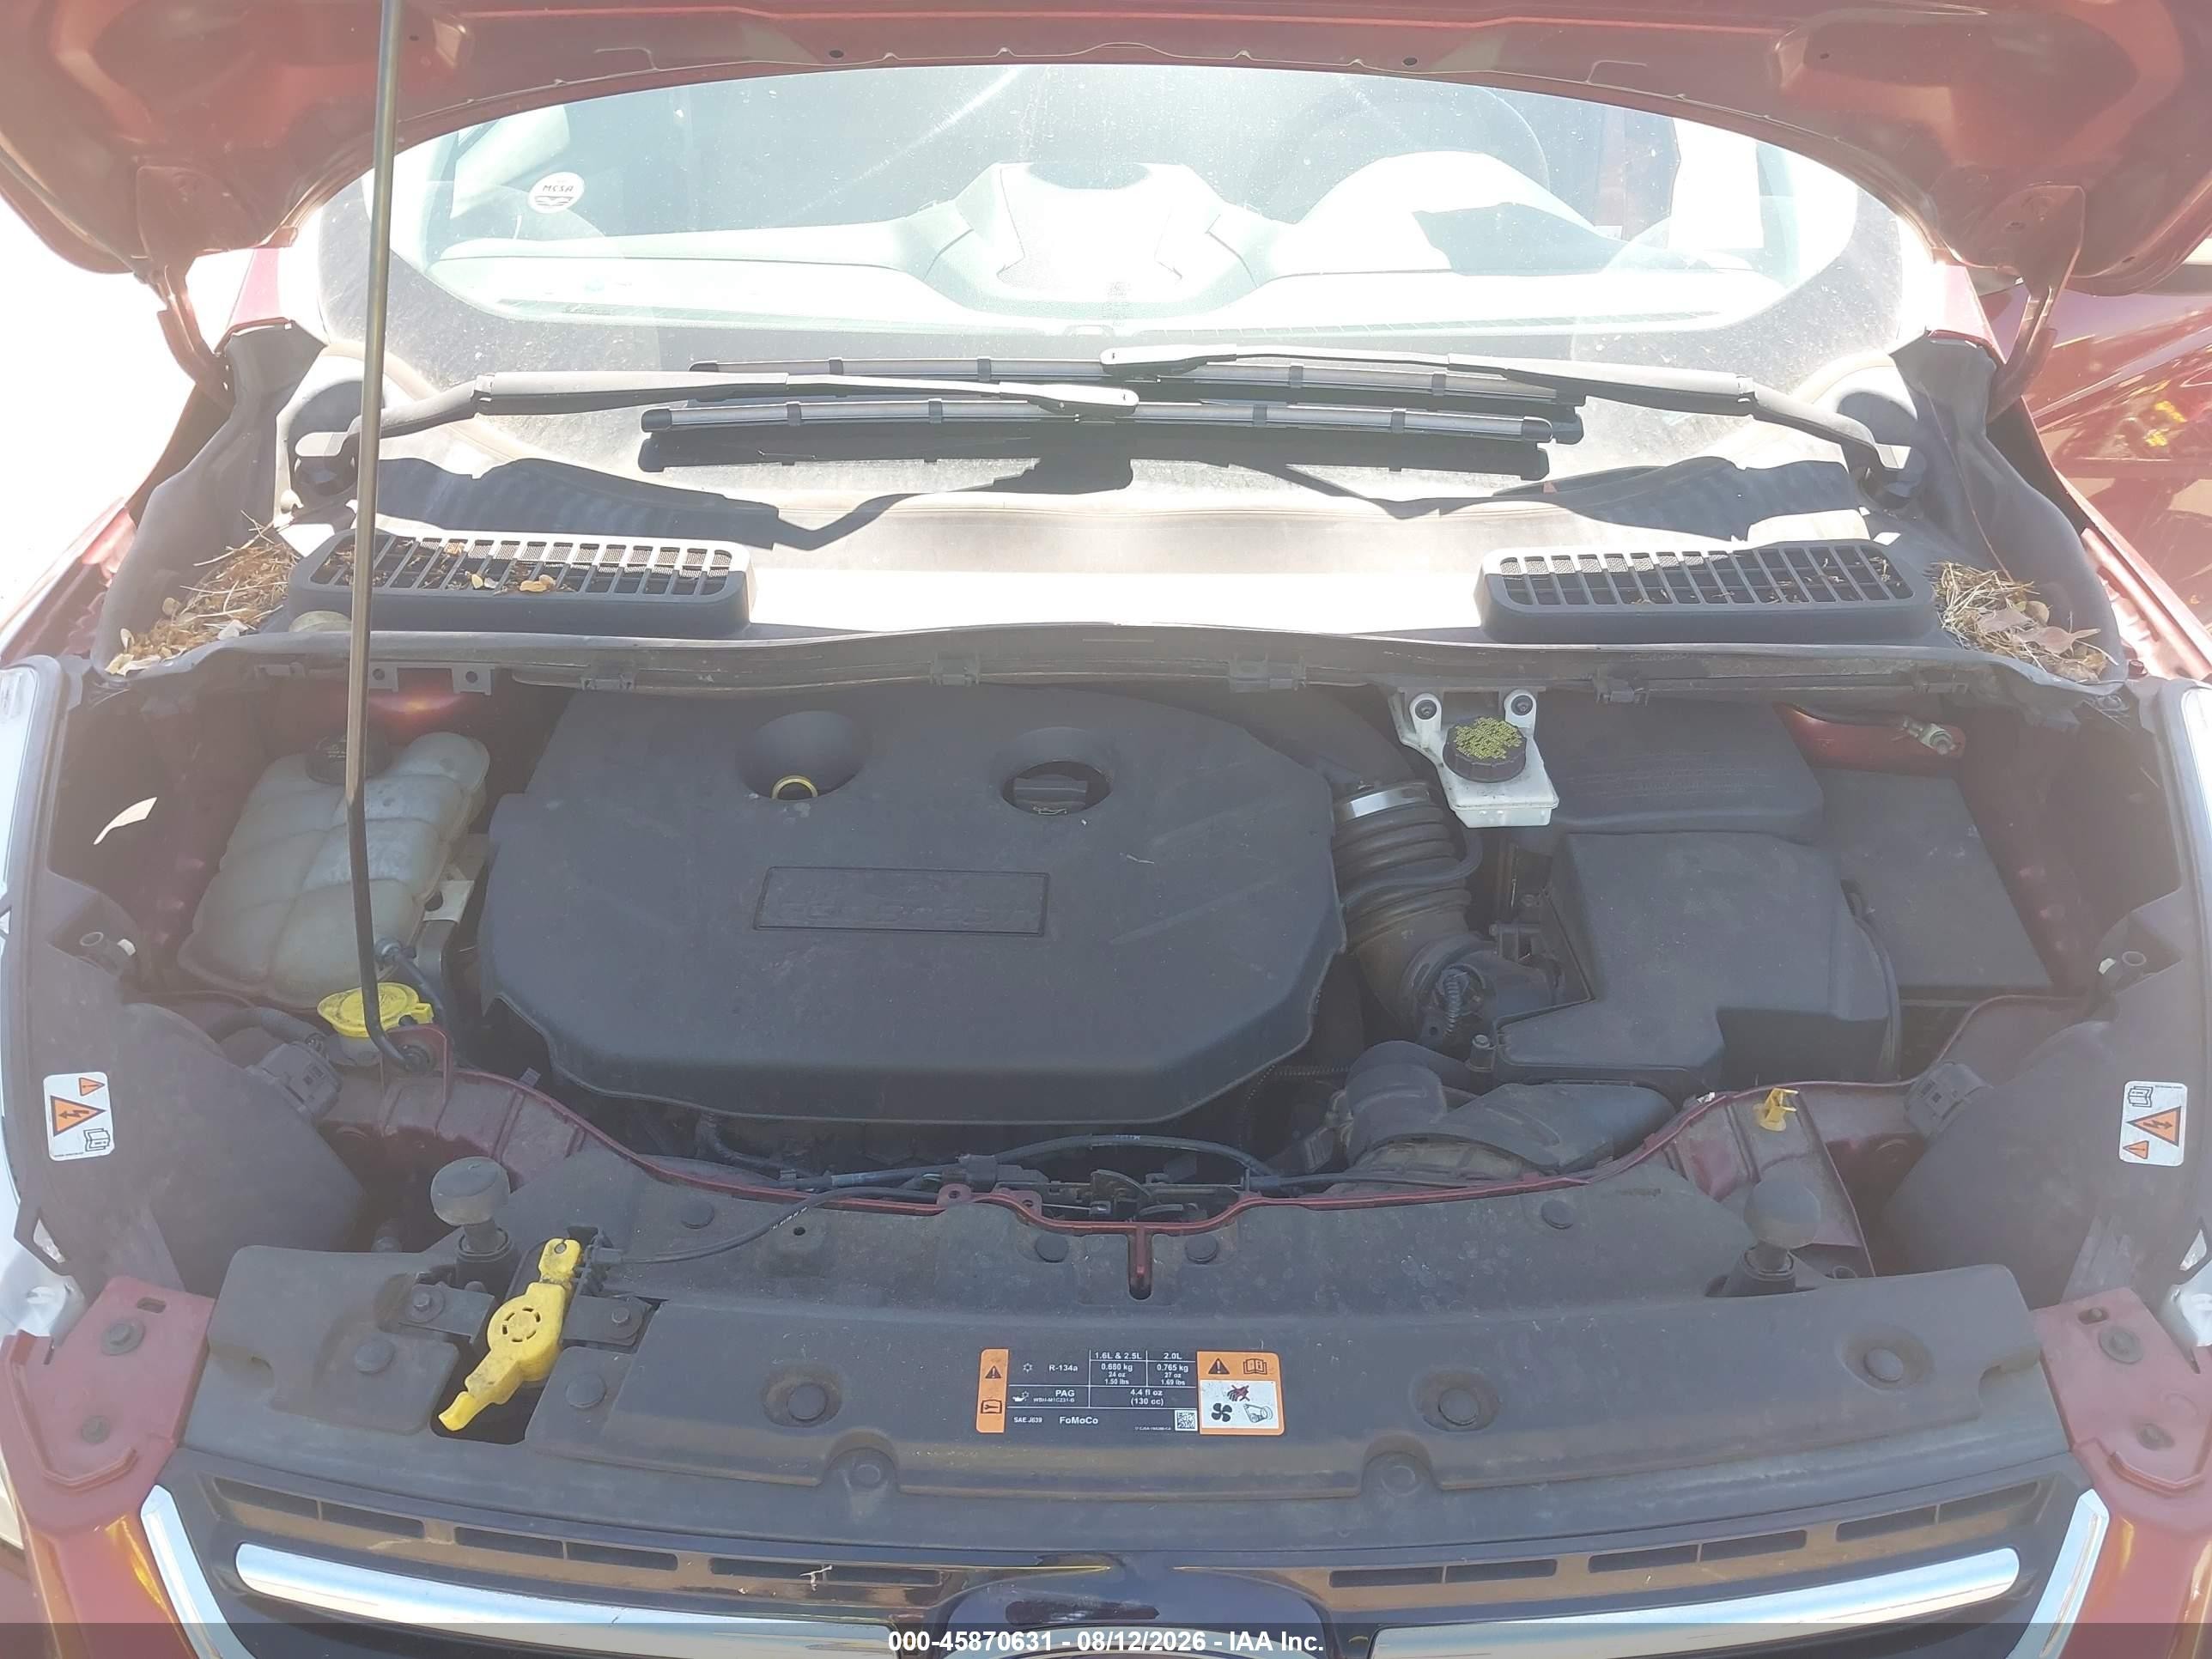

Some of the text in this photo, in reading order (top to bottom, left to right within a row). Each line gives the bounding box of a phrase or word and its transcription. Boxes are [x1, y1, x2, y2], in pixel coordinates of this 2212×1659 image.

[1123, 1363, 1133, 1372] kg
[1179, 1364, 1188, 1373] kg
[1130, 1398, 1164, 1407] (130 cc)
[1059, 1416, 1099, 1425] FoMoCo
